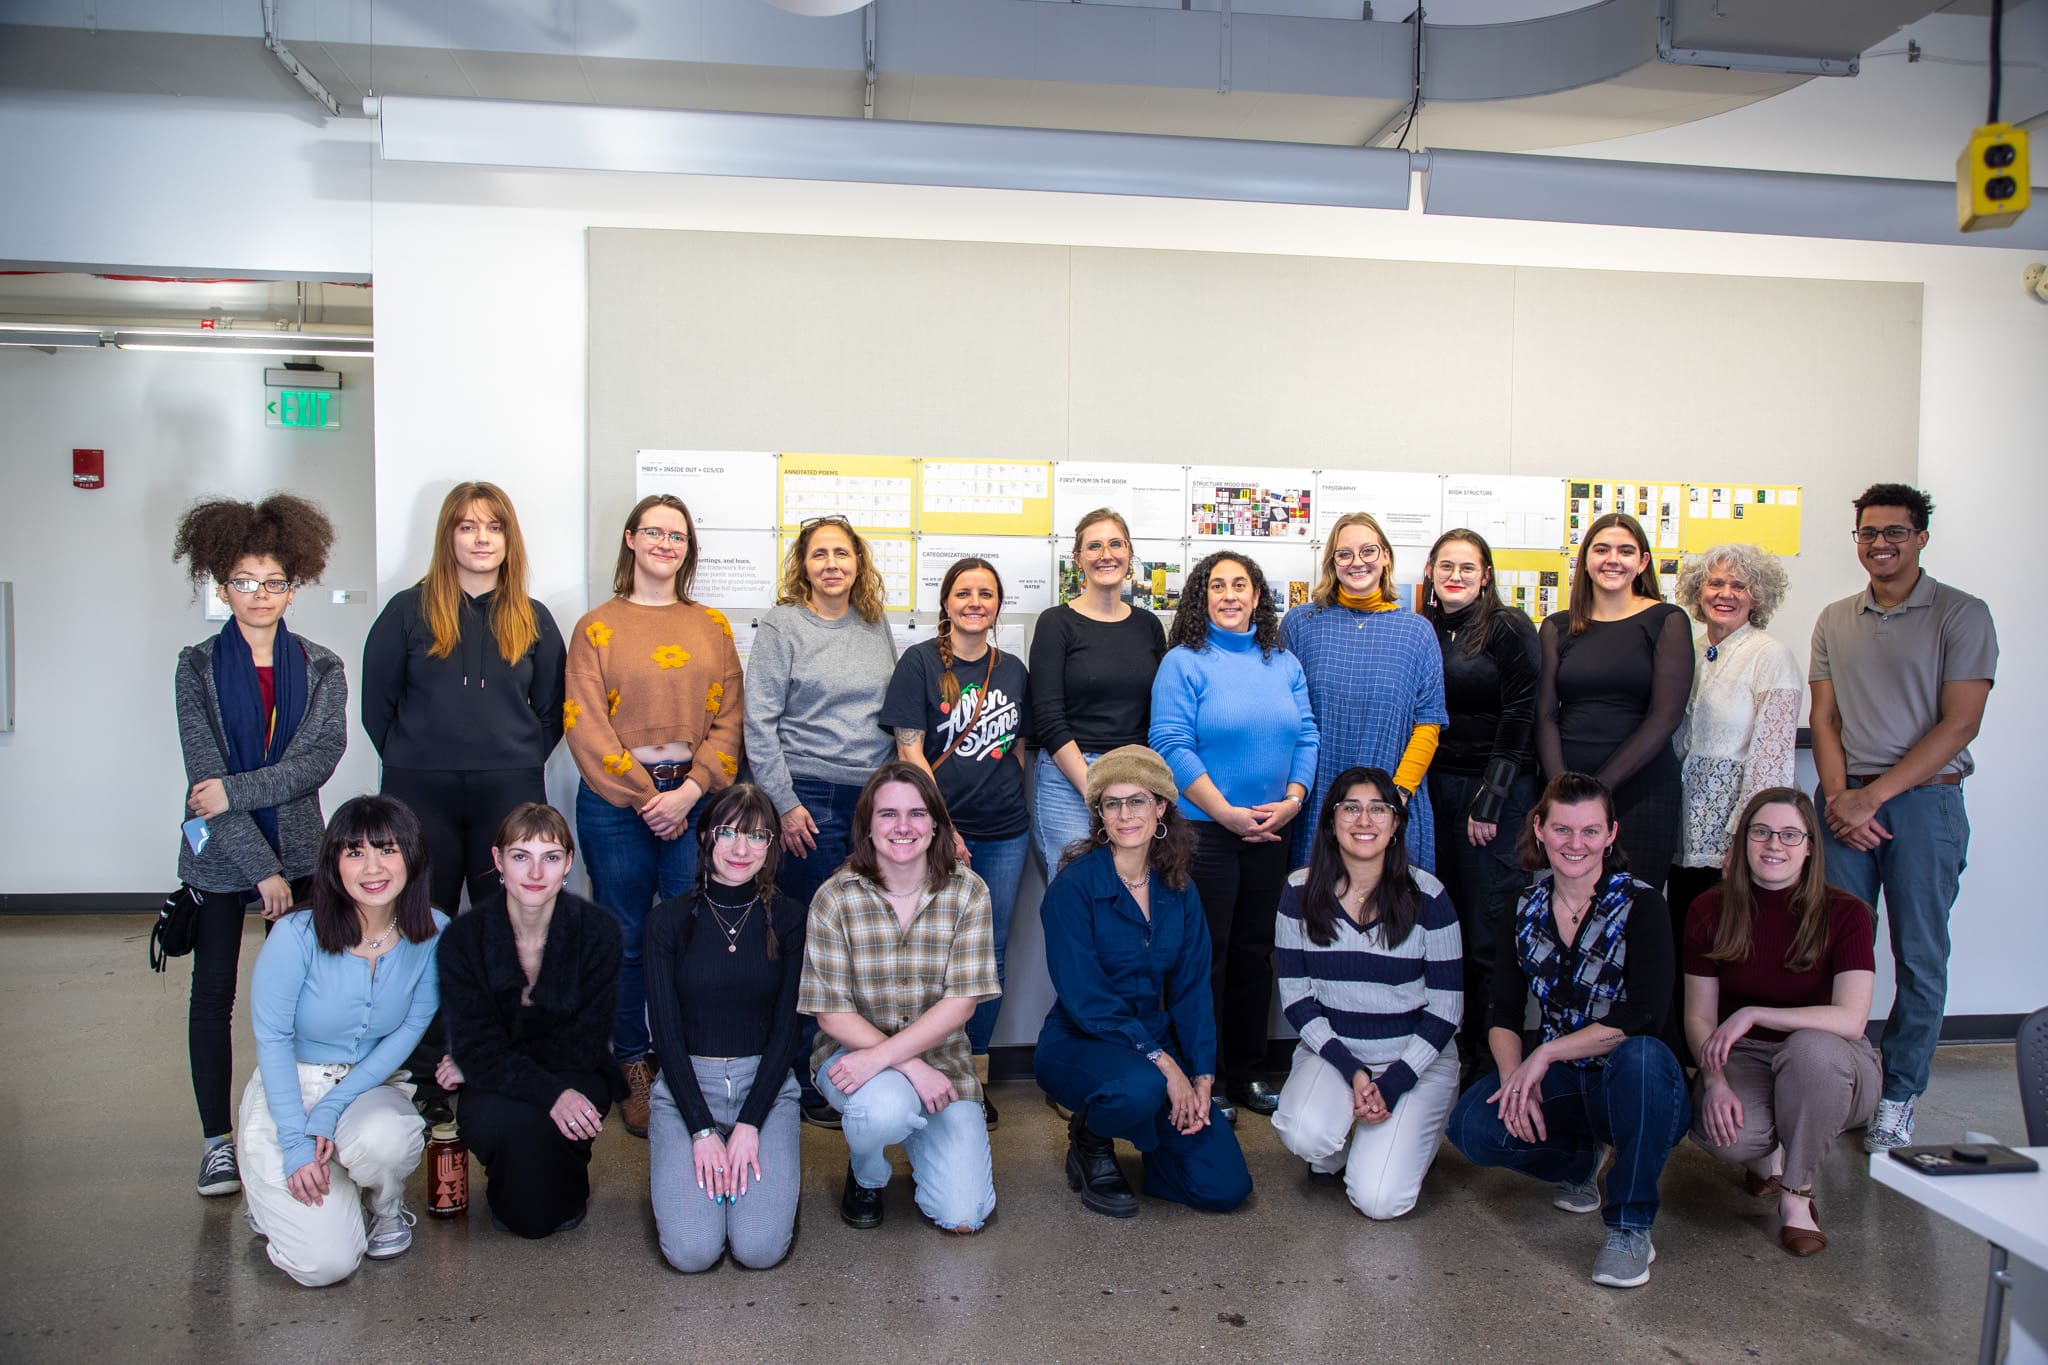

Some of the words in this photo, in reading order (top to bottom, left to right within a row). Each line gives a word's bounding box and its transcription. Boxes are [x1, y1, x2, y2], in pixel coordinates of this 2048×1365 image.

[281, 391, 332, 428] EXIT
[1224, 481, 1241, 489] MOOD
[922, 551, 971, 559] CATEGORIZATION
[955, 708, 1018, 757] Stone
